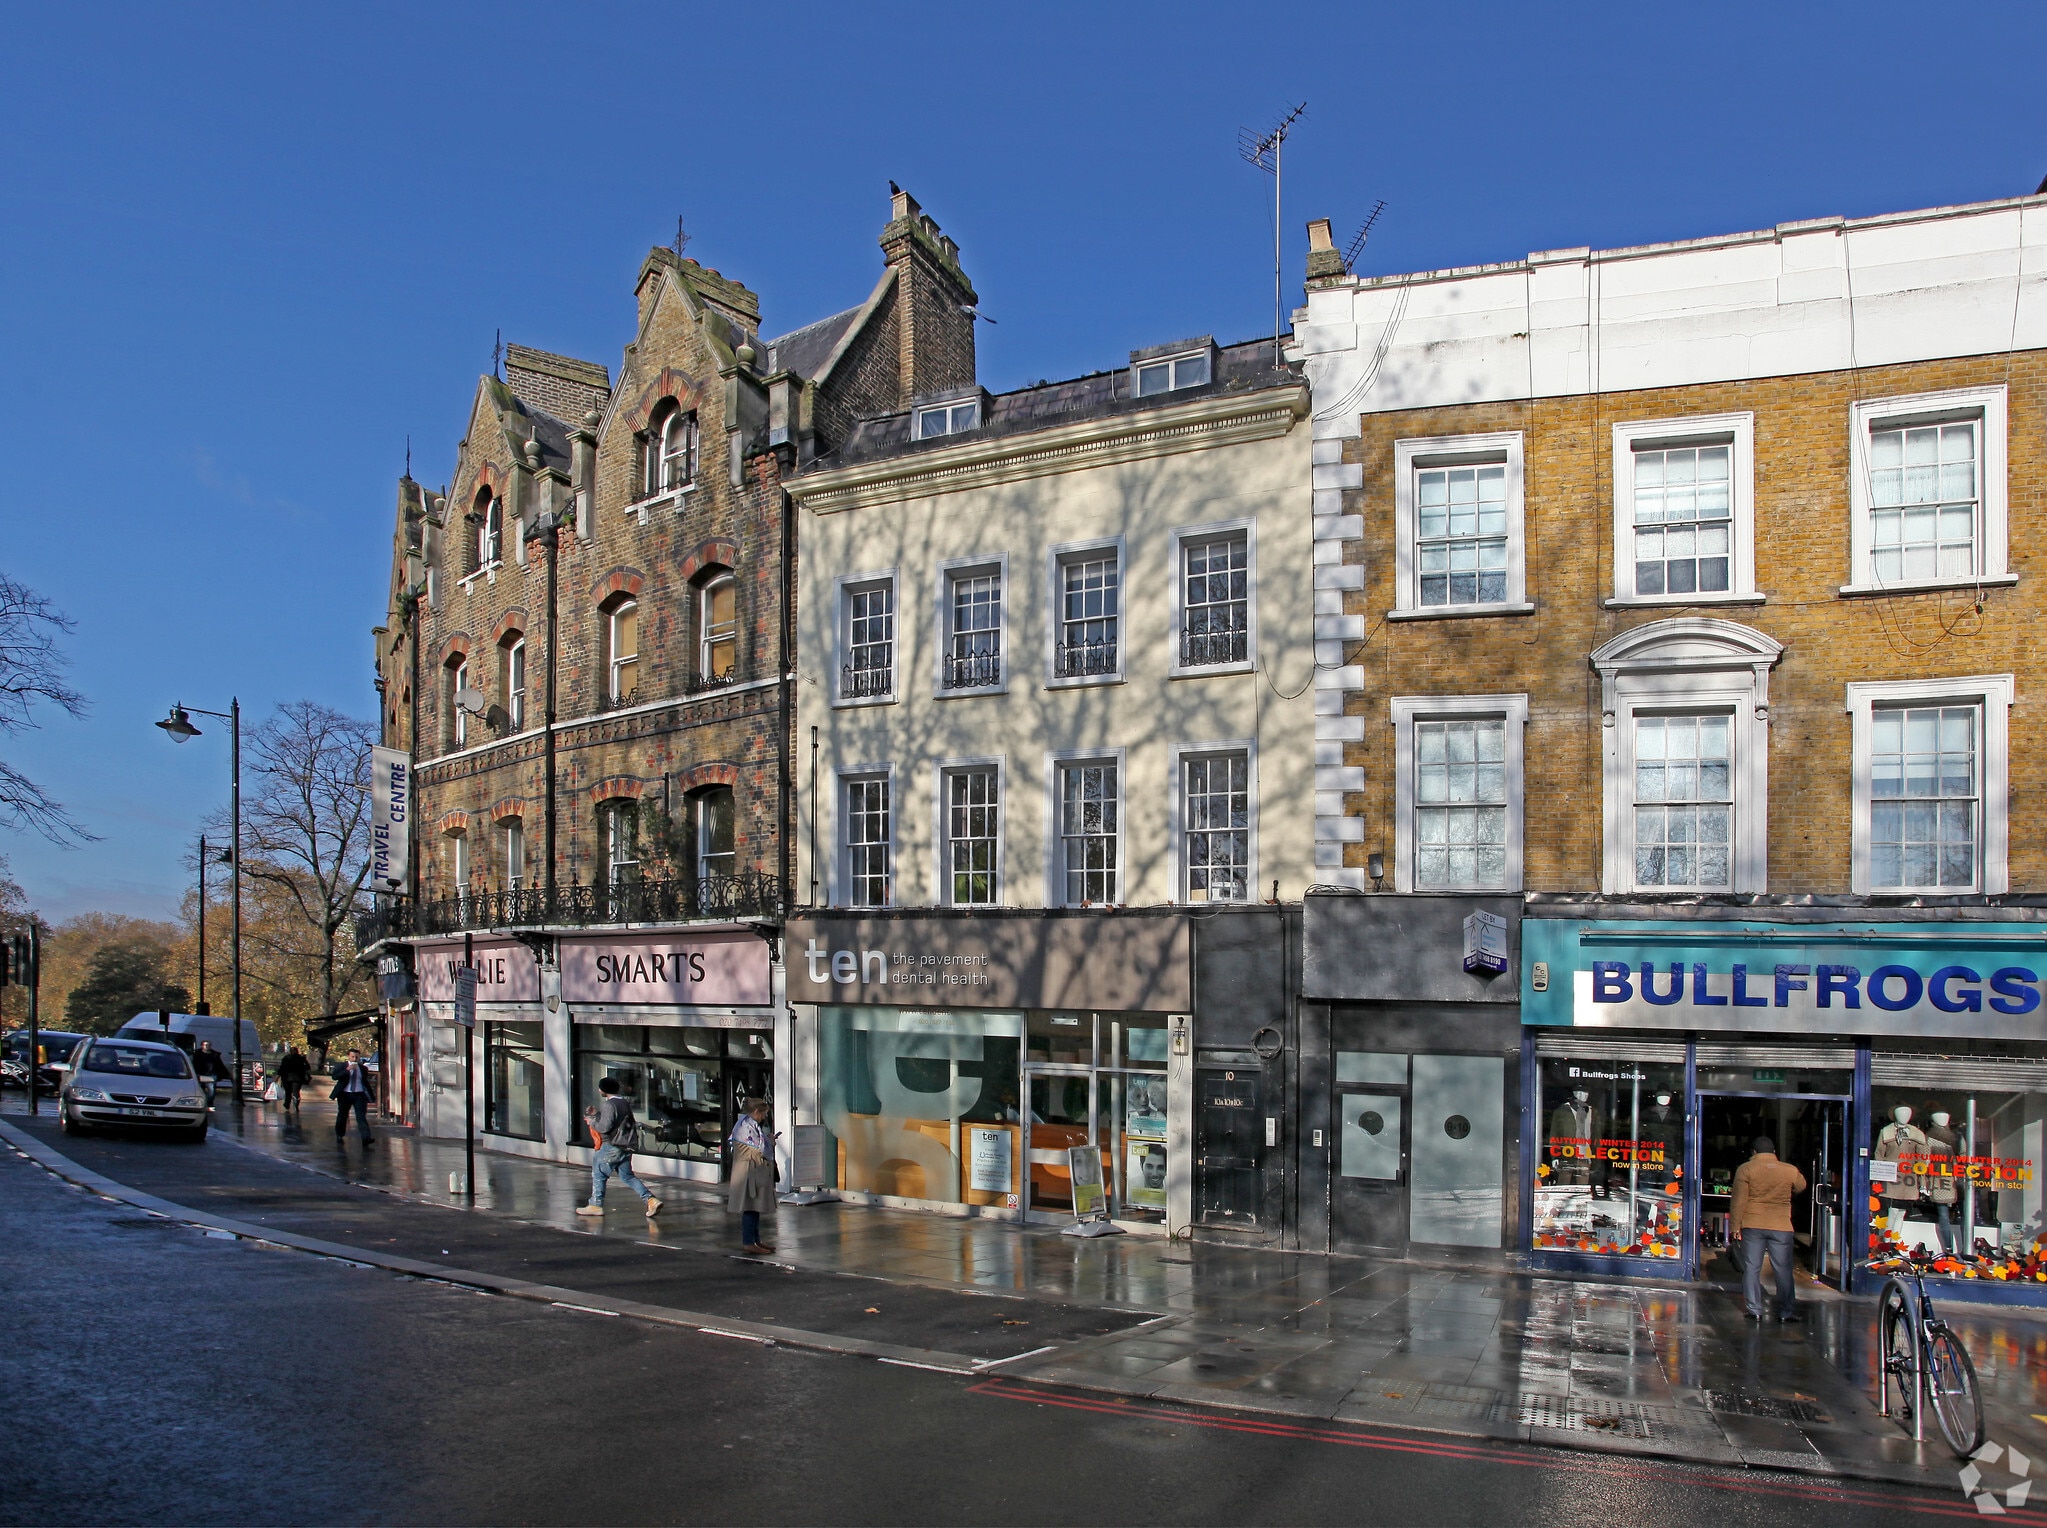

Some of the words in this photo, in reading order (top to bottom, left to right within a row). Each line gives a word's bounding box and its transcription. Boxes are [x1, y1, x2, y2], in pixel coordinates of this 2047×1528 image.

[390, 762, 406, 823] CENTRE
[374, 823, 389, 880] TRAVEL
[804, 938, 888, 984] ten
[892, 952, 915, 965] the
[920, 953, 988, 967] pavement
[596, 952, 706, 983] SMARTS
[892, 971, 936, 984] dental
[942, 971, 989, 985] health
[1592, 960, 2041, 1014] BULLFROGS
[1225, 1071, 1235, 1081] 10
[1582, 1071, 1619, 1080] Bullfrogs
[1620, 1072, 1646, 1080] Shoes
[982, 1131, 999, 1141] ten
[1549, 1137, 1592, 1145] AUTUMN
[1599, 1139, 1639, 1147] WINTER
[1640, 1141, 1665, 1149] 2014
[1132, 1146, 1148, 1155] ten
[1549, 1145, 1665, 1162] COLLECTION
[1612, 1161, 1630, 1169] now
[1642, 1162, 1664, 1171] store
[1898, 1152, 1948, 1162] AUTUMN
[1955, 1154, 2001, 1165] WINTER
[2005, 1157, 2032, 1167] 2014
[1898, 1161, 2033, 1181] COLLECTION
[1972, 1179, 1992, 1188] now
[1995, 1179, 2005, 1188] in
